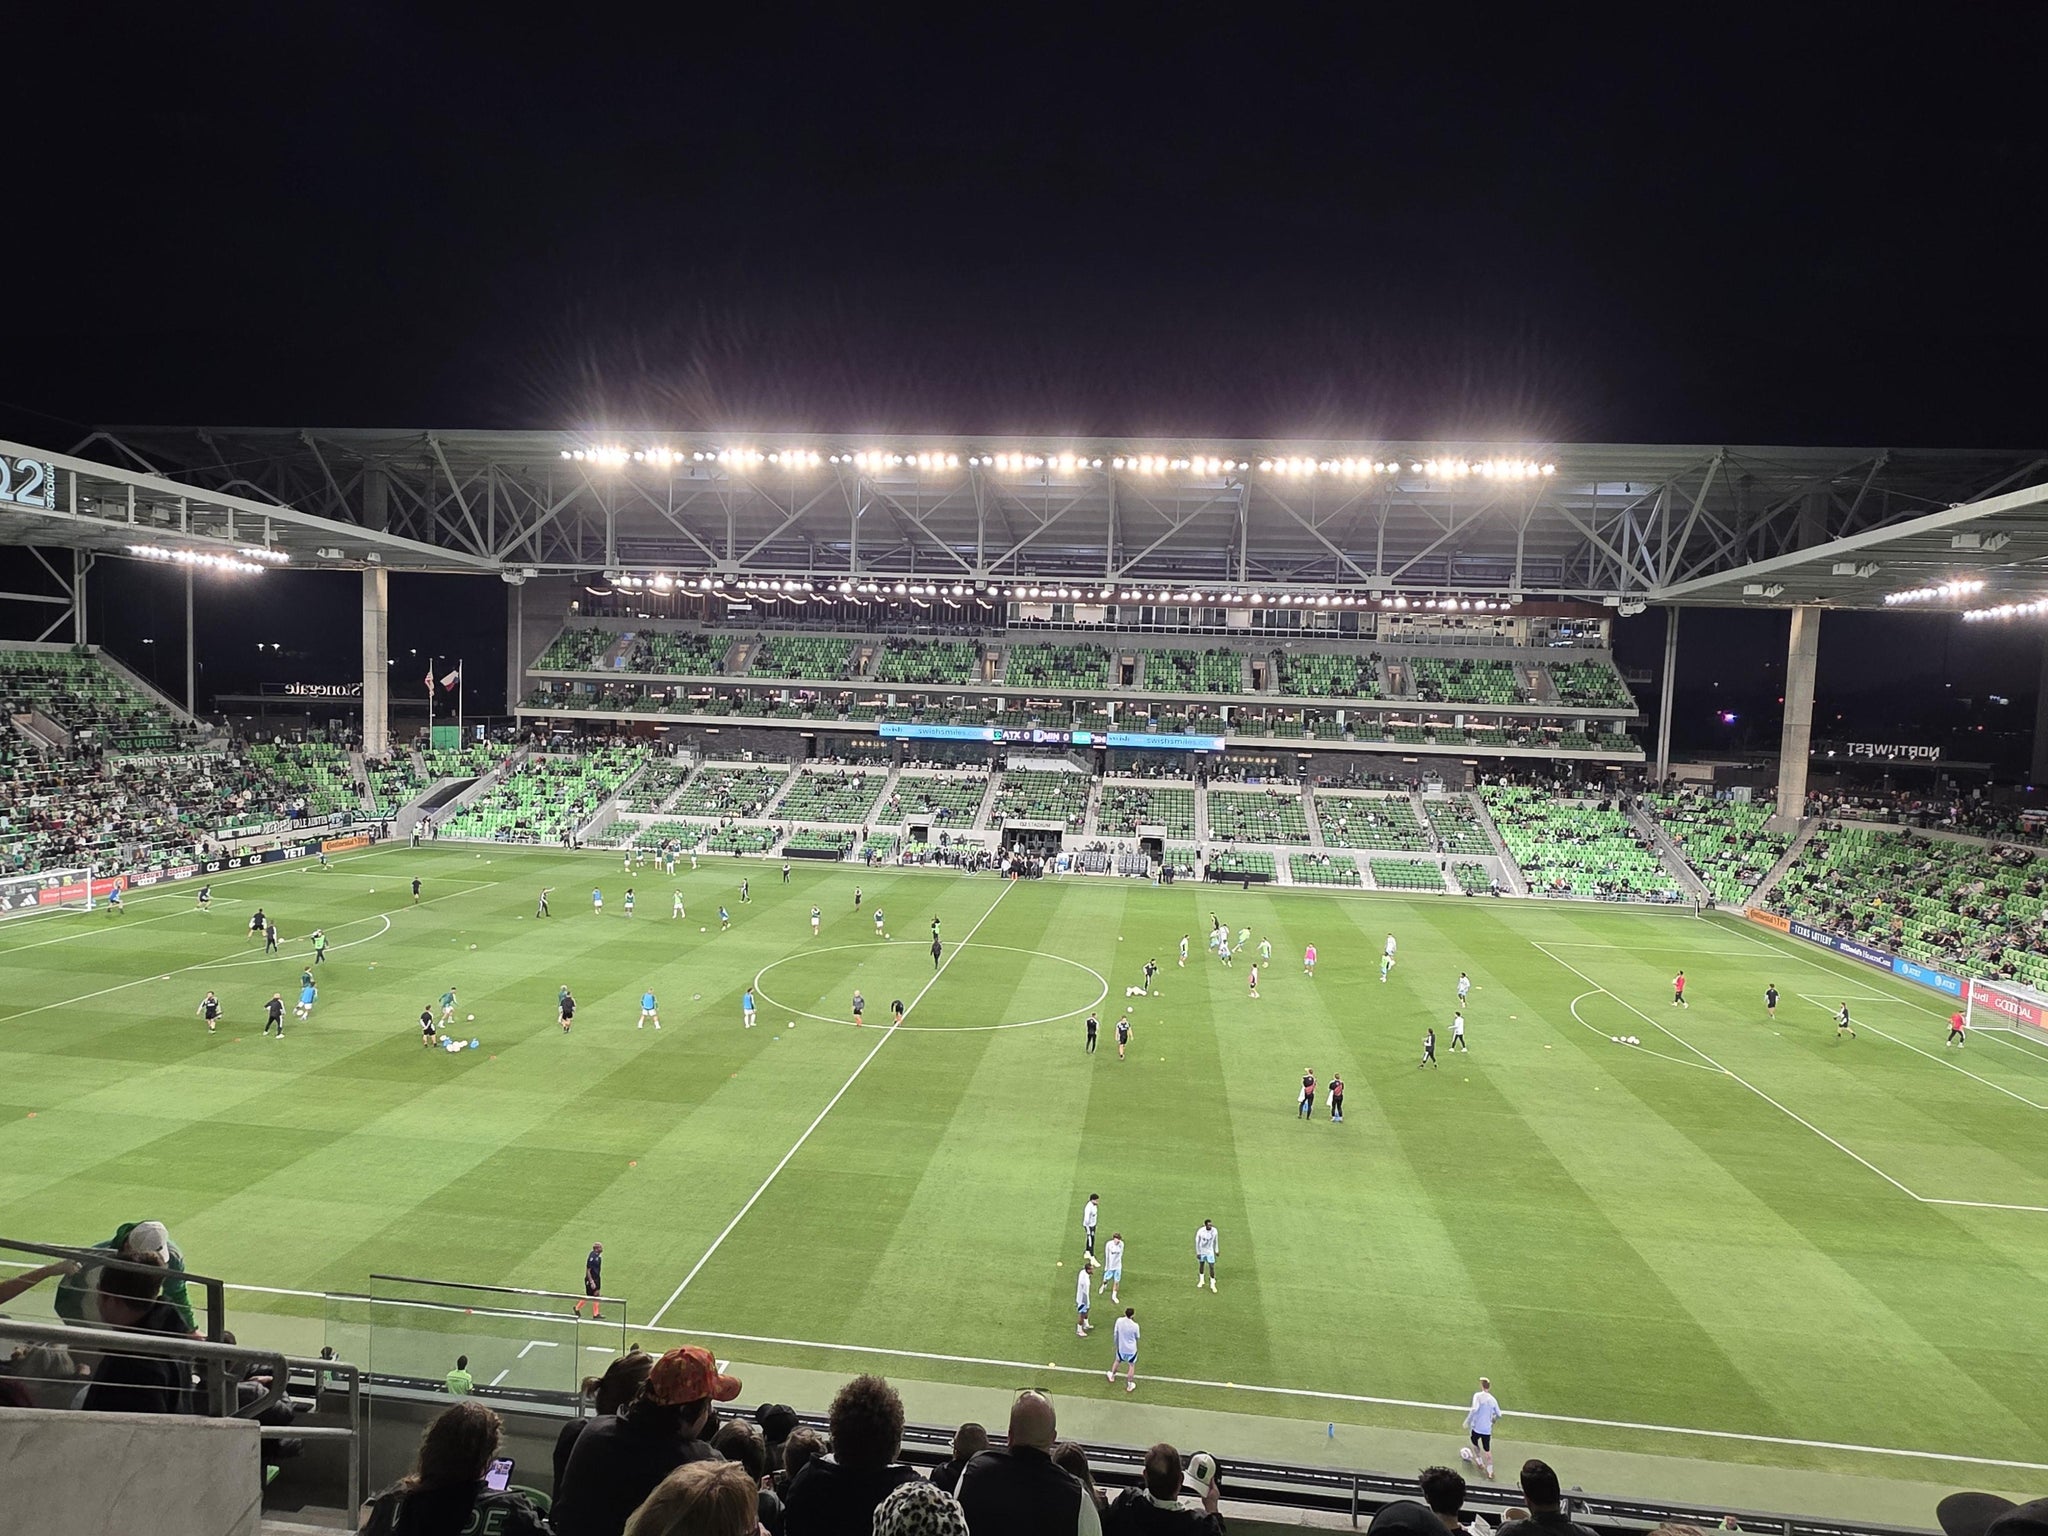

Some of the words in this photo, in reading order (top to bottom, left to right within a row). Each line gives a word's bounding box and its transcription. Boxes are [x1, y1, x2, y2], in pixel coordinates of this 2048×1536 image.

[0, 456, 45, 506] 2
[46, 462, 55, 510] STADIUM
[1002, 731, 1021, 740] ATX
[1023, 732, 1030, 740] 0
[1043, 732, 1060, 741] MIN
[1063, 733, 1070, 742] 0
[135, 738, 175, 748] VERDES
[327, 838, 354, 850] Continental
[283, 846, 306, 859] YETI
[229, 858, 242, 868] Q2
[250, 855, 262, 864] Q2
[207, 862, 220, 872] Q2
[130, 870, 164, 882] DISCOUNT
[1795, 925, 1811, 938] TEXAS
[1811, 930, 1833, 946] LOTTERY
